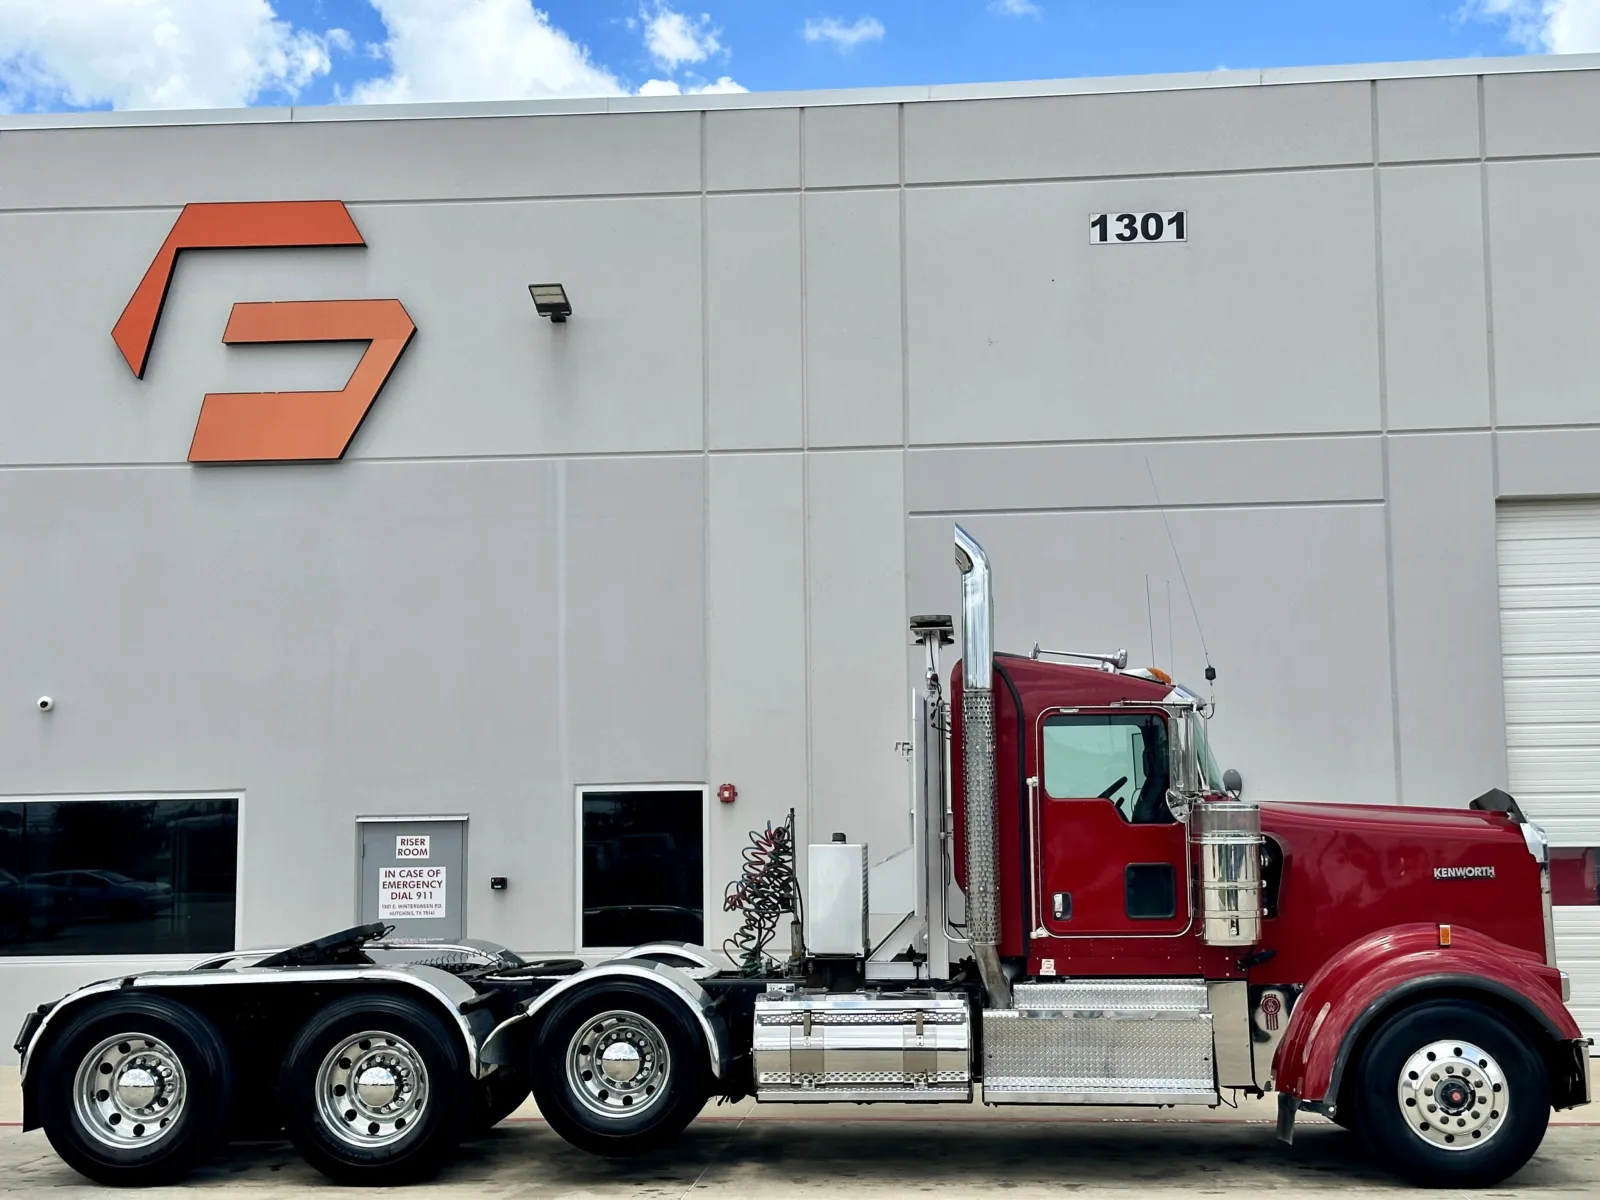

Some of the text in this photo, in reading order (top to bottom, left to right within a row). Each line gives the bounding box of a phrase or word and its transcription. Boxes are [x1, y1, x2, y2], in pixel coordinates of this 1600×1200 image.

[1091, 212, 1184, 242] 1301
[400, 838, 426, 846] RISER
[397, 848, 428, 856] ROOM
[384, 869, 441, 878] IN CASE OF
[1433, 866, 1495, 877] KENWORTH
[382, 880, 443, 889] EMERGENCY
[390, 891, 433, 900] DIAL 911
